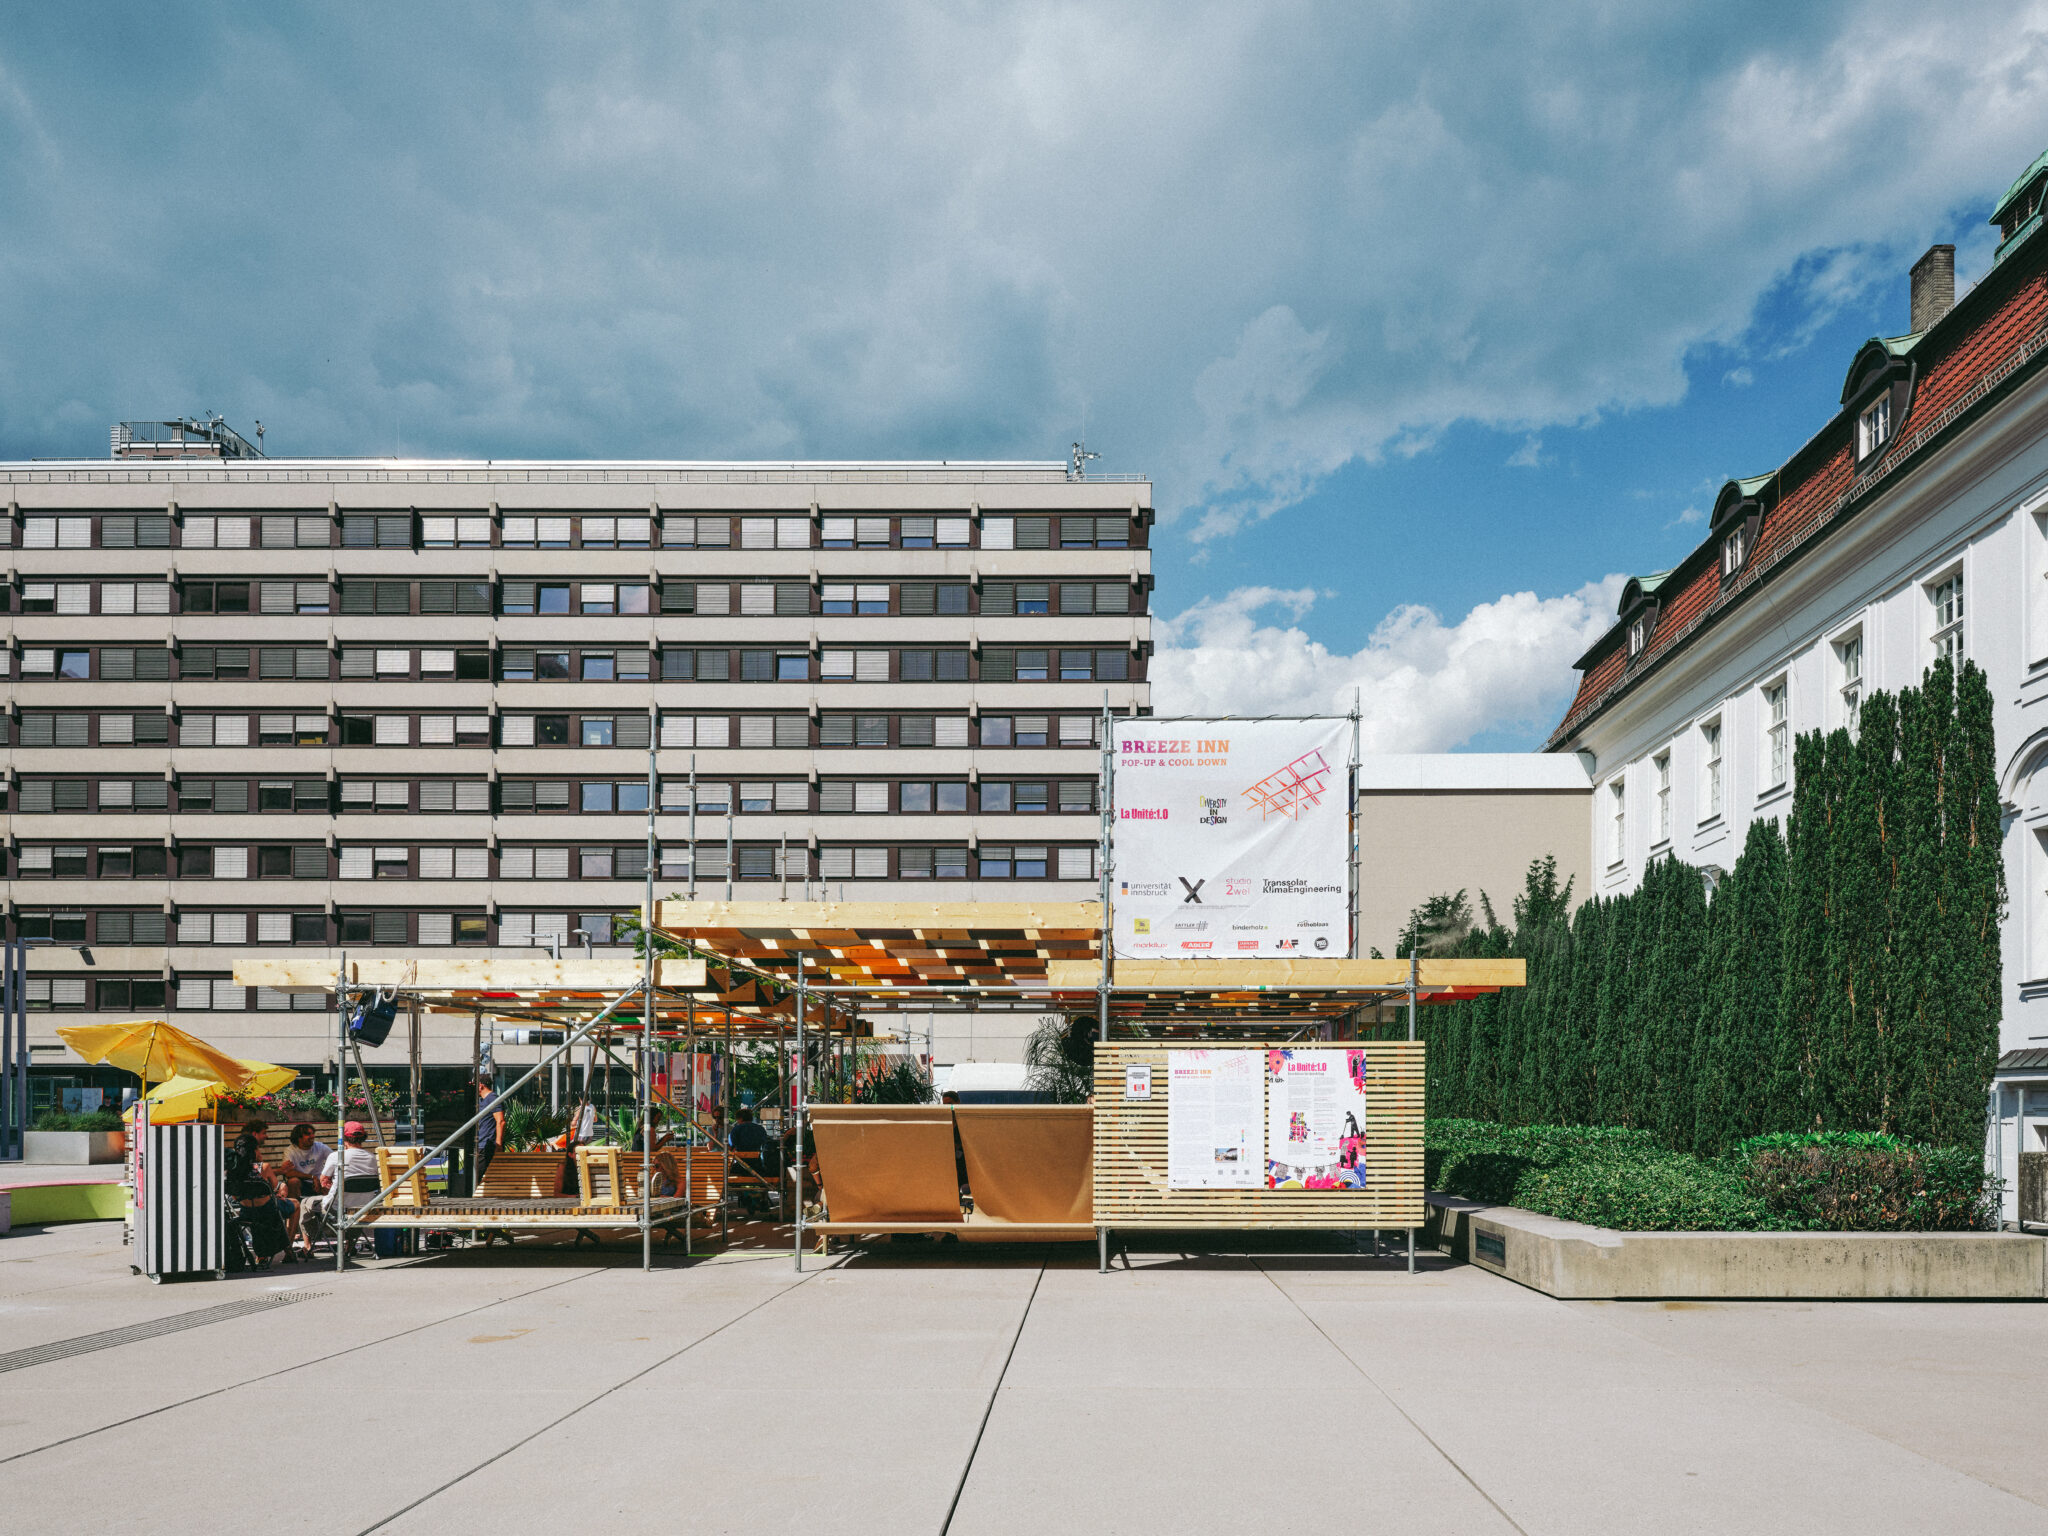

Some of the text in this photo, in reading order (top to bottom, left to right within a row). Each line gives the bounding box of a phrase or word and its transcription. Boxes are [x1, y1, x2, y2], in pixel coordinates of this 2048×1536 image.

[1121, 740, 1230, 753] BREEZE INN
[1121, 758, 1228, 767] POP-UP & COOL DOWN
[1120, 808, 1169, 820] La Unité:1.0
[1200, 816, 1228, 825] DESIGN
[1225, 877, 1252, 885] studio
[1262, 879, 1308, 887] Transsolar
[1130, 882, 1172, 890] universität
[1226, 885, 1250, 895] 2wei
[1262, 884, 1342, 895] KlimaEngineering
[1288, 1062, 1296, 1071] La
